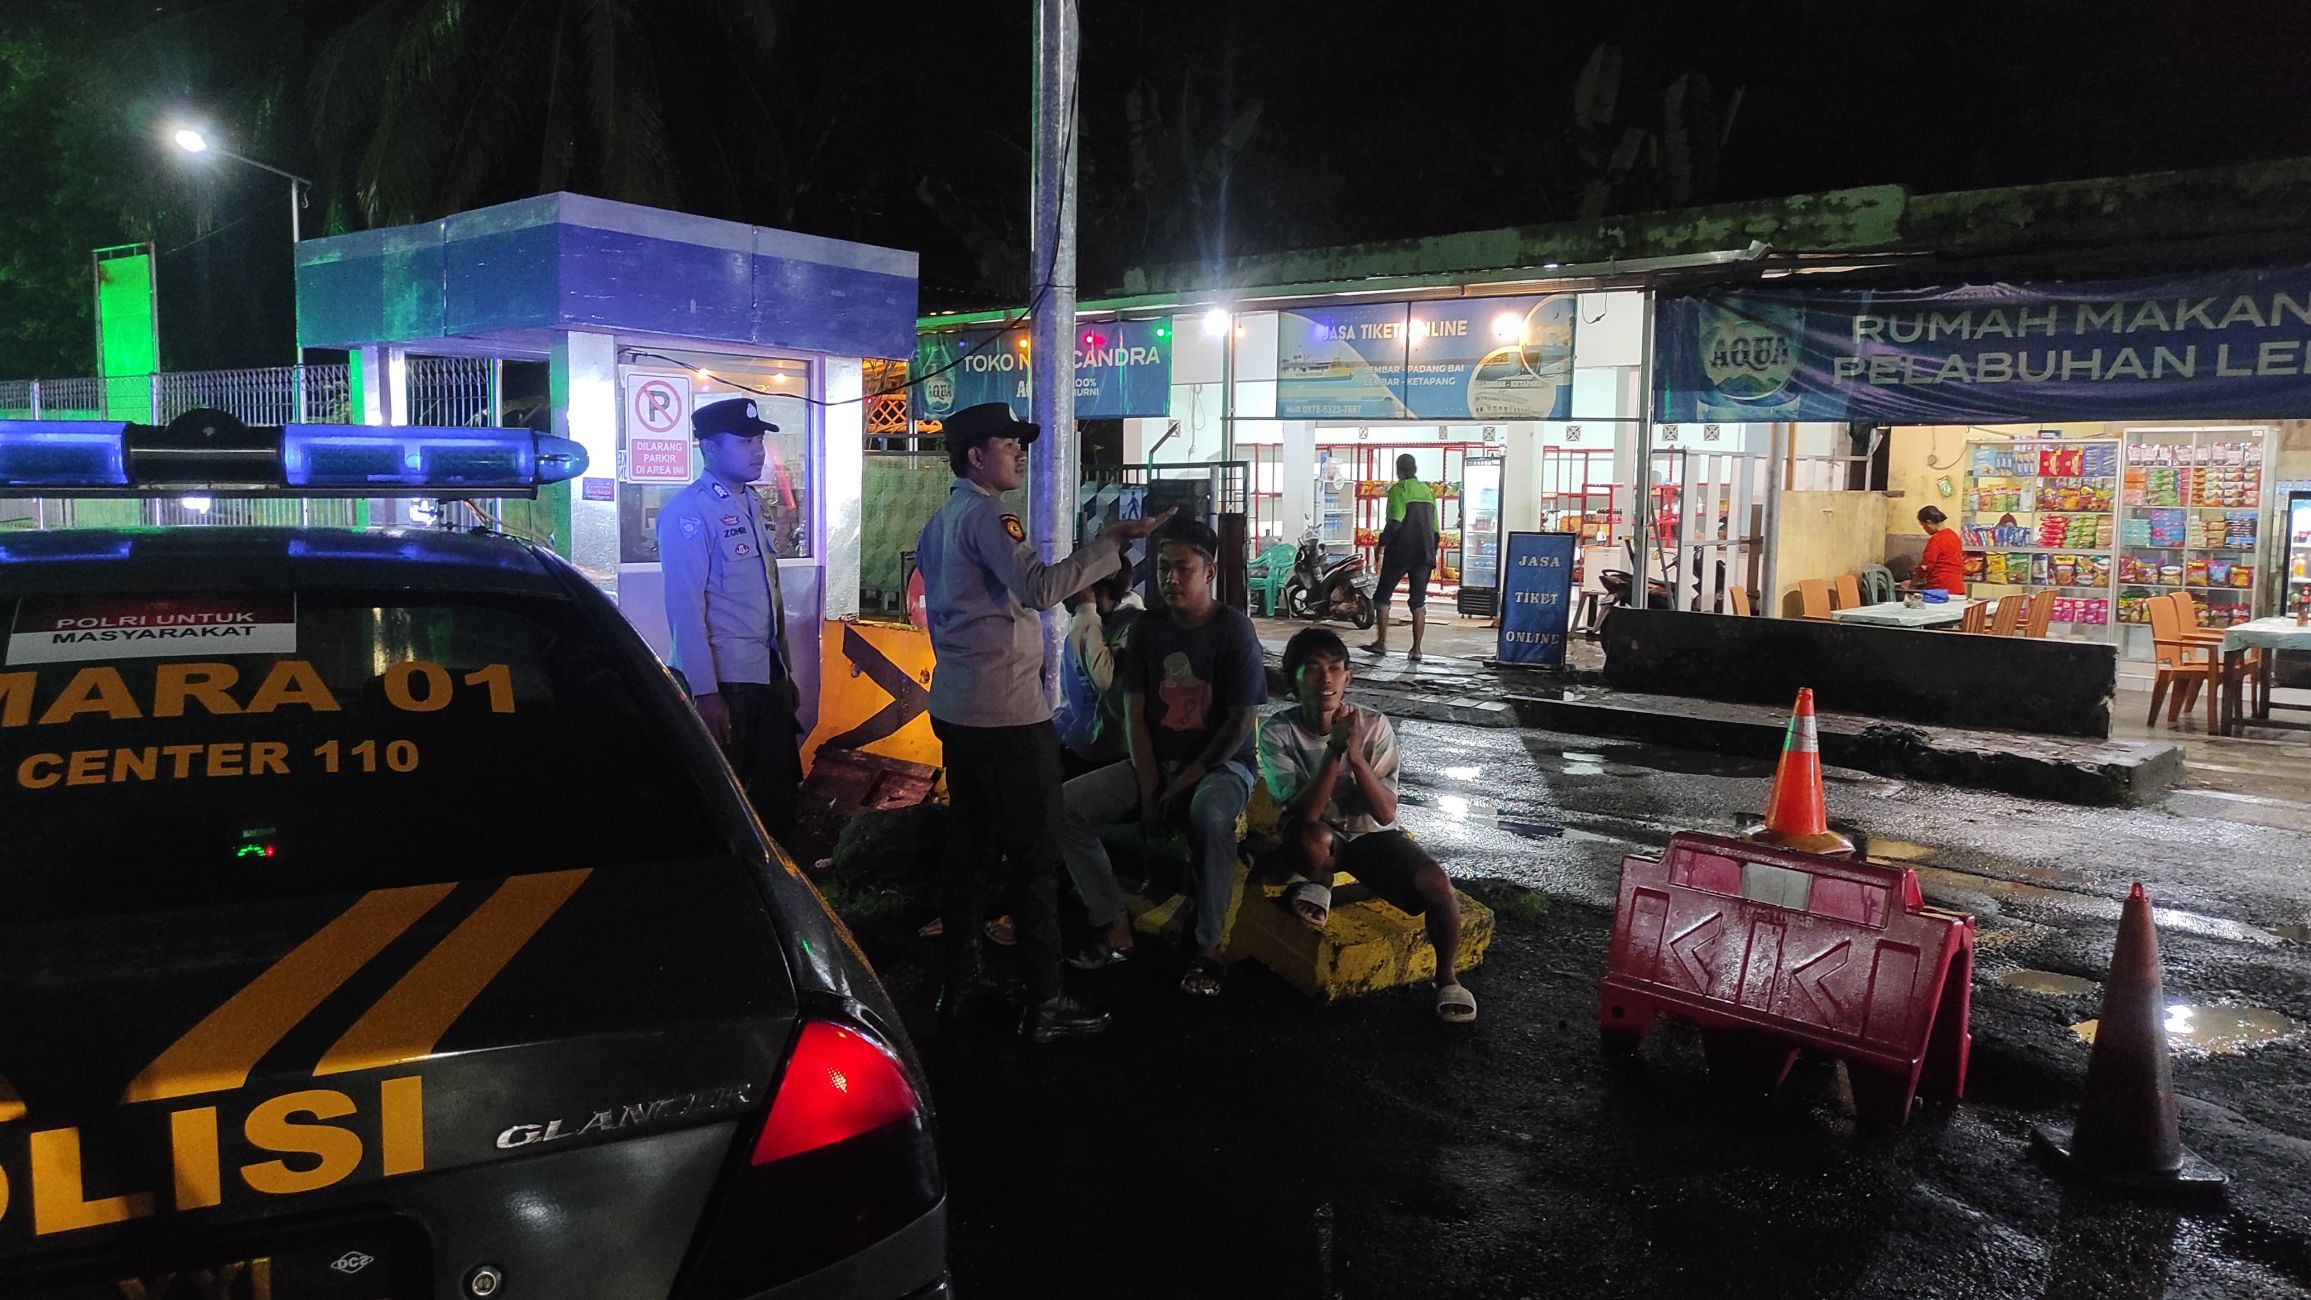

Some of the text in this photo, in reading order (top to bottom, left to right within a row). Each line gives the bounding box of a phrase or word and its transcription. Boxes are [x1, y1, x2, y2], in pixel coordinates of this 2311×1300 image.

[1852, 291, 2311, 344] RUMAH MAKAN
[1322, 319, 1468, 341] JASA TIKET NLINE
[1711, 336, 1789, 370] AQUA
[963, 353, 1014, 373] TOKO
[1367, 365, 1400, 374] EMBAR
[1407, 364, 1446, 374] PADANG
[1447, 363, 1465, 373] BAI
[1832, 340, 2311, 385] PELABUHAN LE
[1074, 378, 1097, 388] 00%
[1406, 377, 1456, 386] KETAPANG
[928, 384, 952, 400] AQUA
[636, 441, 683, 452] DILARANG
[643, 453, 677, 464] PARKIR
[635, 464, 685, 476] DI AREA INI
[1518, 555, 1561, 567] JASA
[1514, 591, 1559, 605] TIKET
[56, 612, 255, 630] POLRI UNTUK
[52, 626, 257, 644] MASYARAKAT
[1505, 630, 1561, 645] ONLINE
[382, 660, 518, 716] 01
[17, 740, 420, 789] CENTER 110
[0, 1076, 426, 1237] LISI
